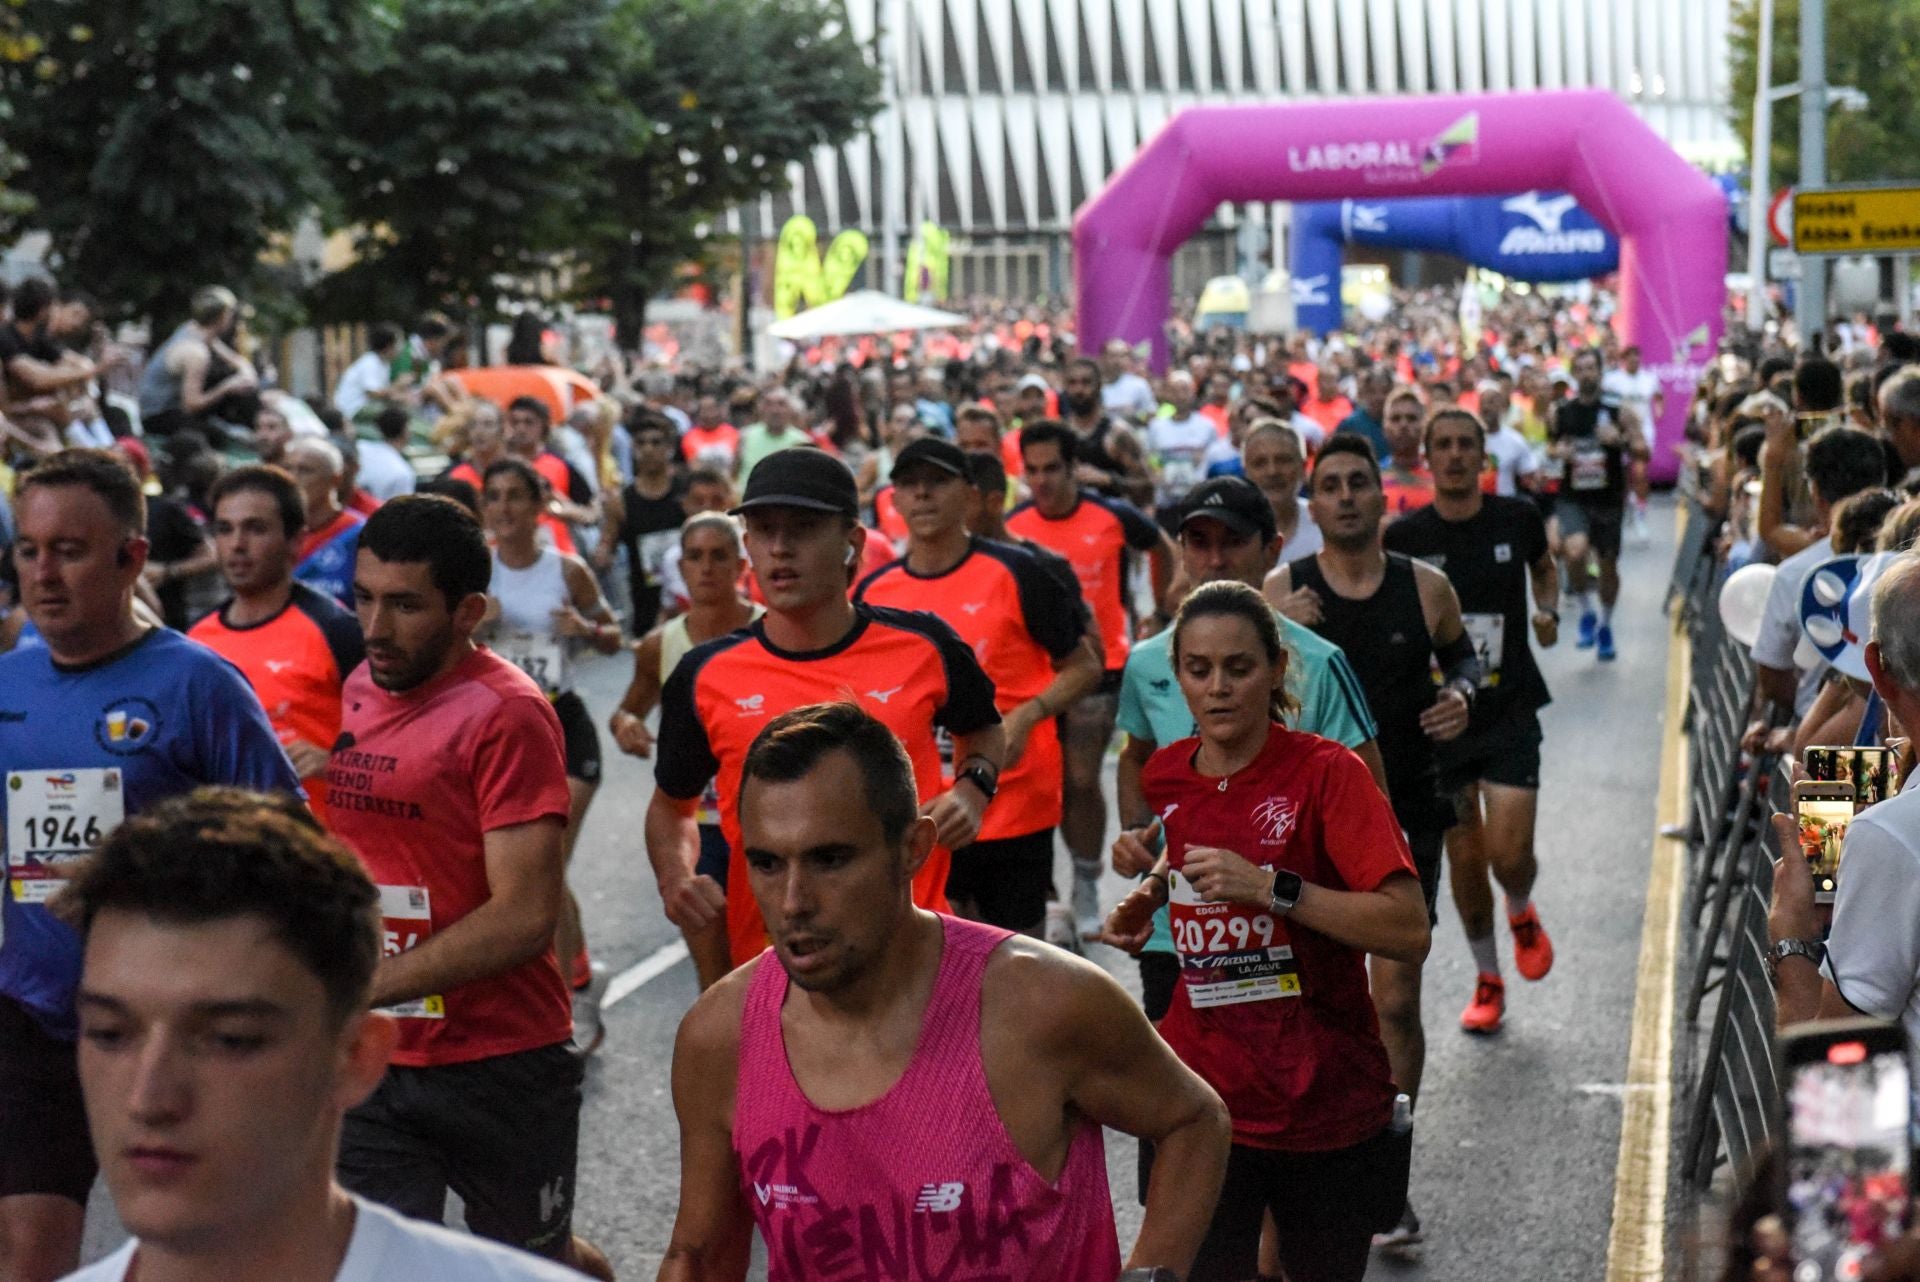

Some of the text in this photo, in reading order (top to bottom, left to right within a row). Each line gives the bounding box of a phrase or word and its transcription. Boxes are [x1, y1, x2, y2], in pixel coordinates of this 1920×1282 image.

[1287, 140, 1416, 172] LABORAL
[25, 815, 103, 848] 1946
[1195, 905, 1229, 915] EDGAR
[1174, 914, 1274, 953] 20299
[1286, 979, 1295, 989] 3
